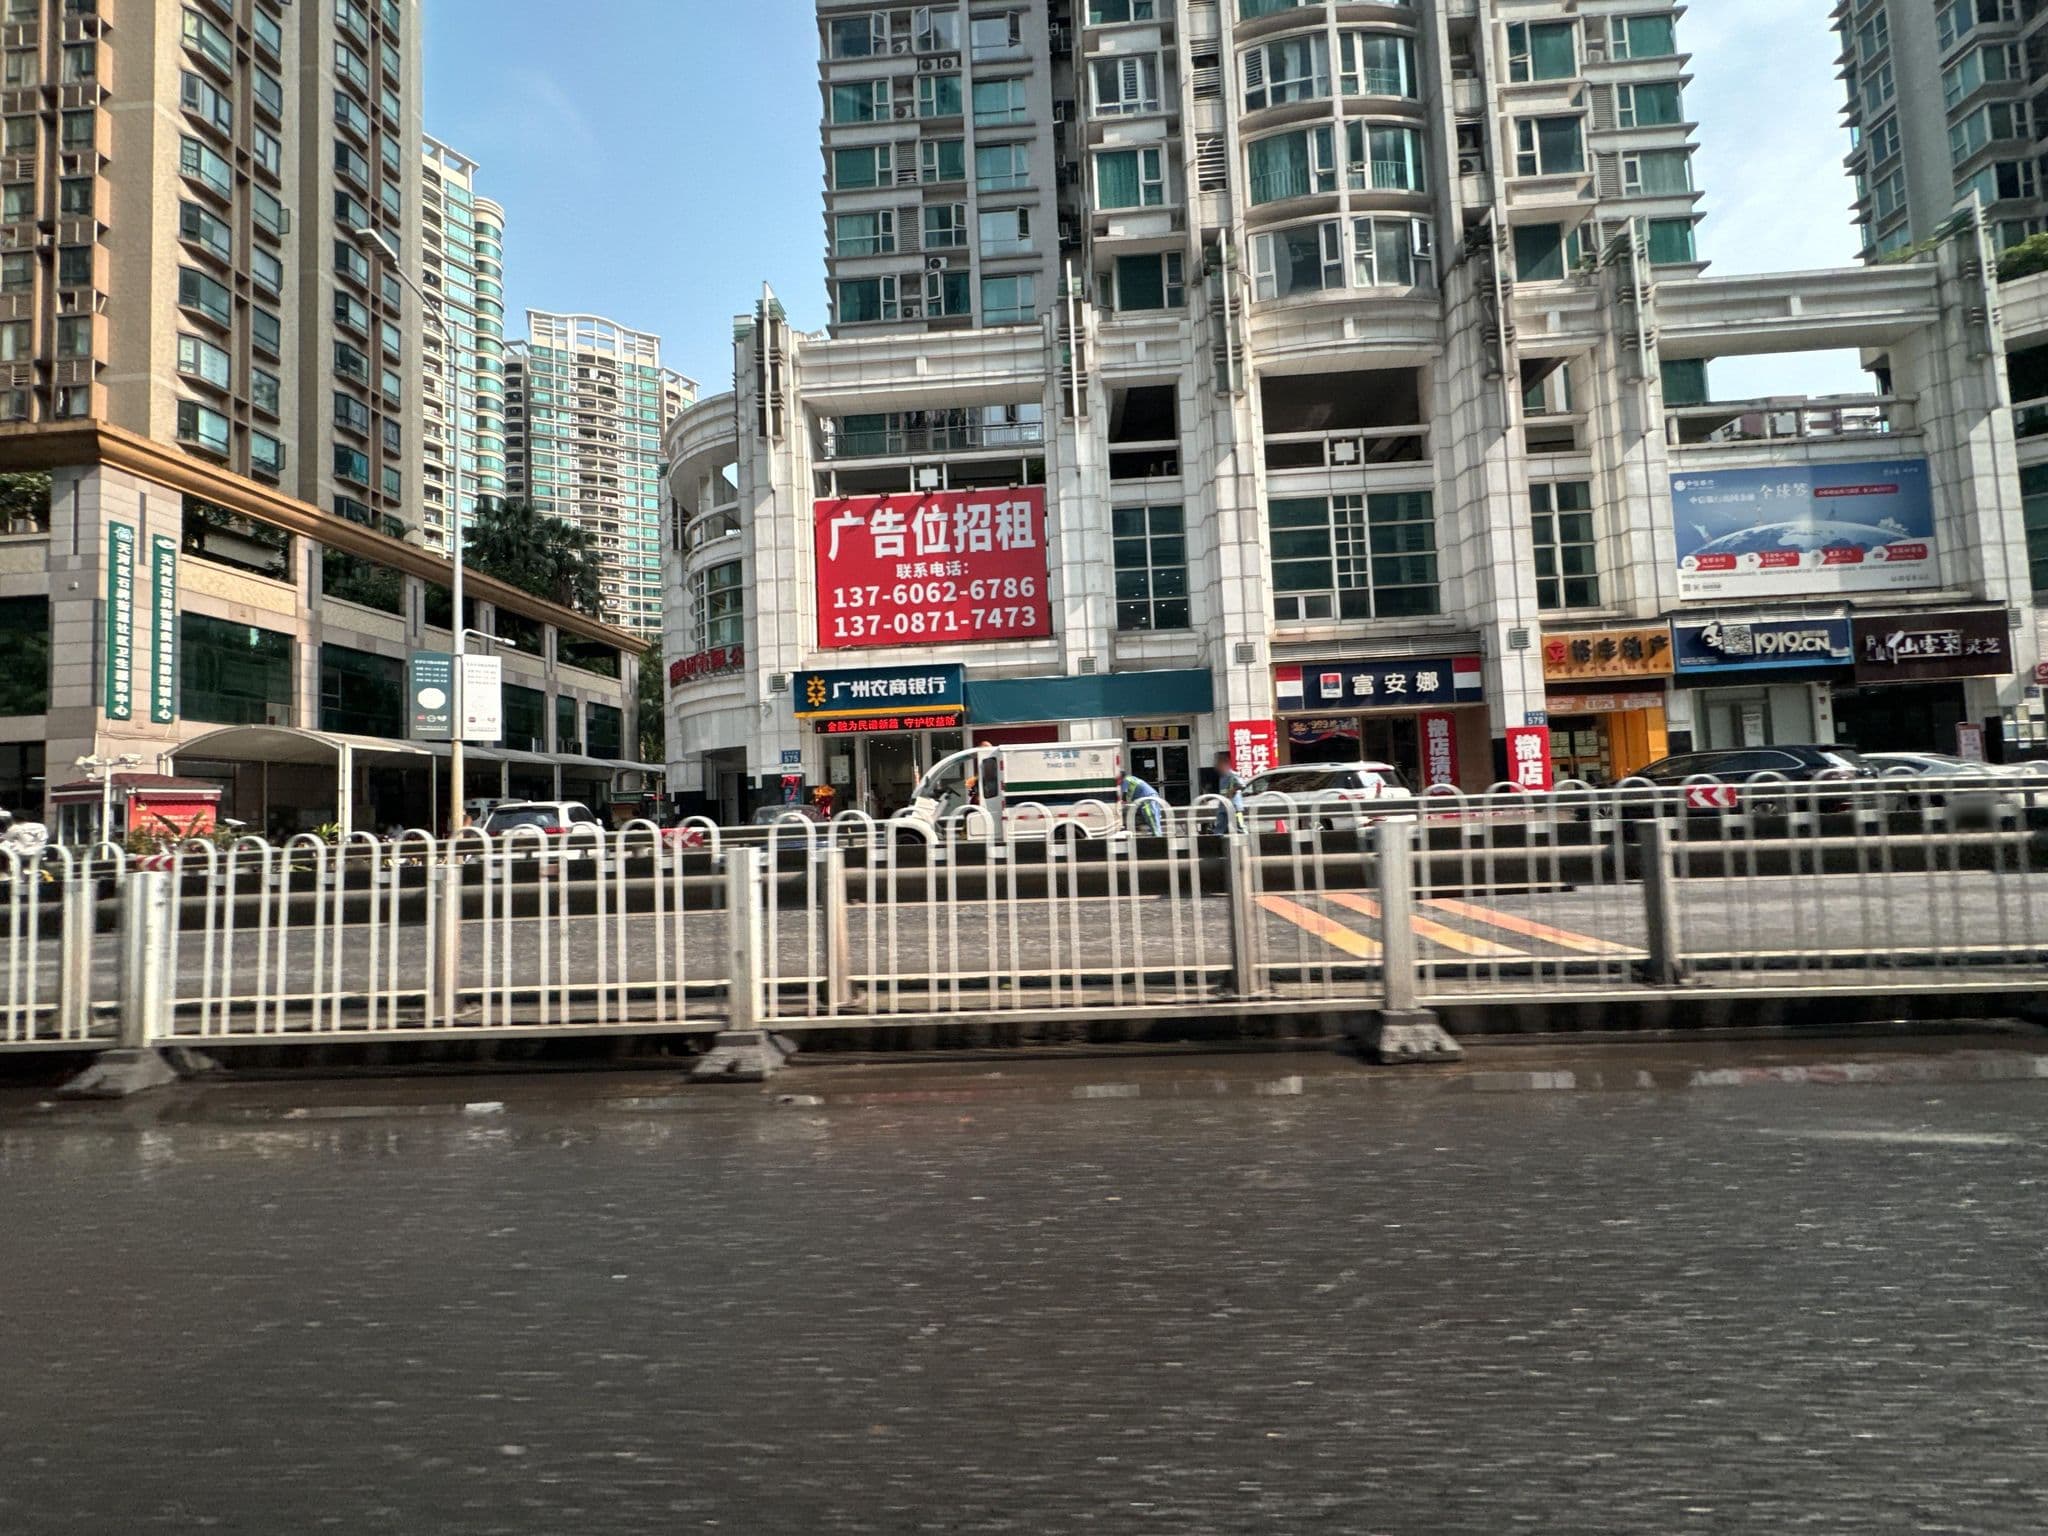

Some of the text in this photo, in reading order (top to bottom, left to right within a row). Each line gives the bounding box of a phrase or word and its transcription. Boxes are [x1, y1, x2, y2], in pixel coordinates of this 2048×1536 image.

[828, 500, 1036, 561] 广告位招租
[833, 576, 1036, 609] 137-6062-6786
[834, 606, 1036, 638] 137-0871-7473
[832, 676, 947, 699] 广州农商银行
[1351, 671, 1440, 696] 富安娜
[1527, 716, 1545, 725] 579
[783, 754, 799, 763] 575
[1514, 734, 1545, 791] 撤店
